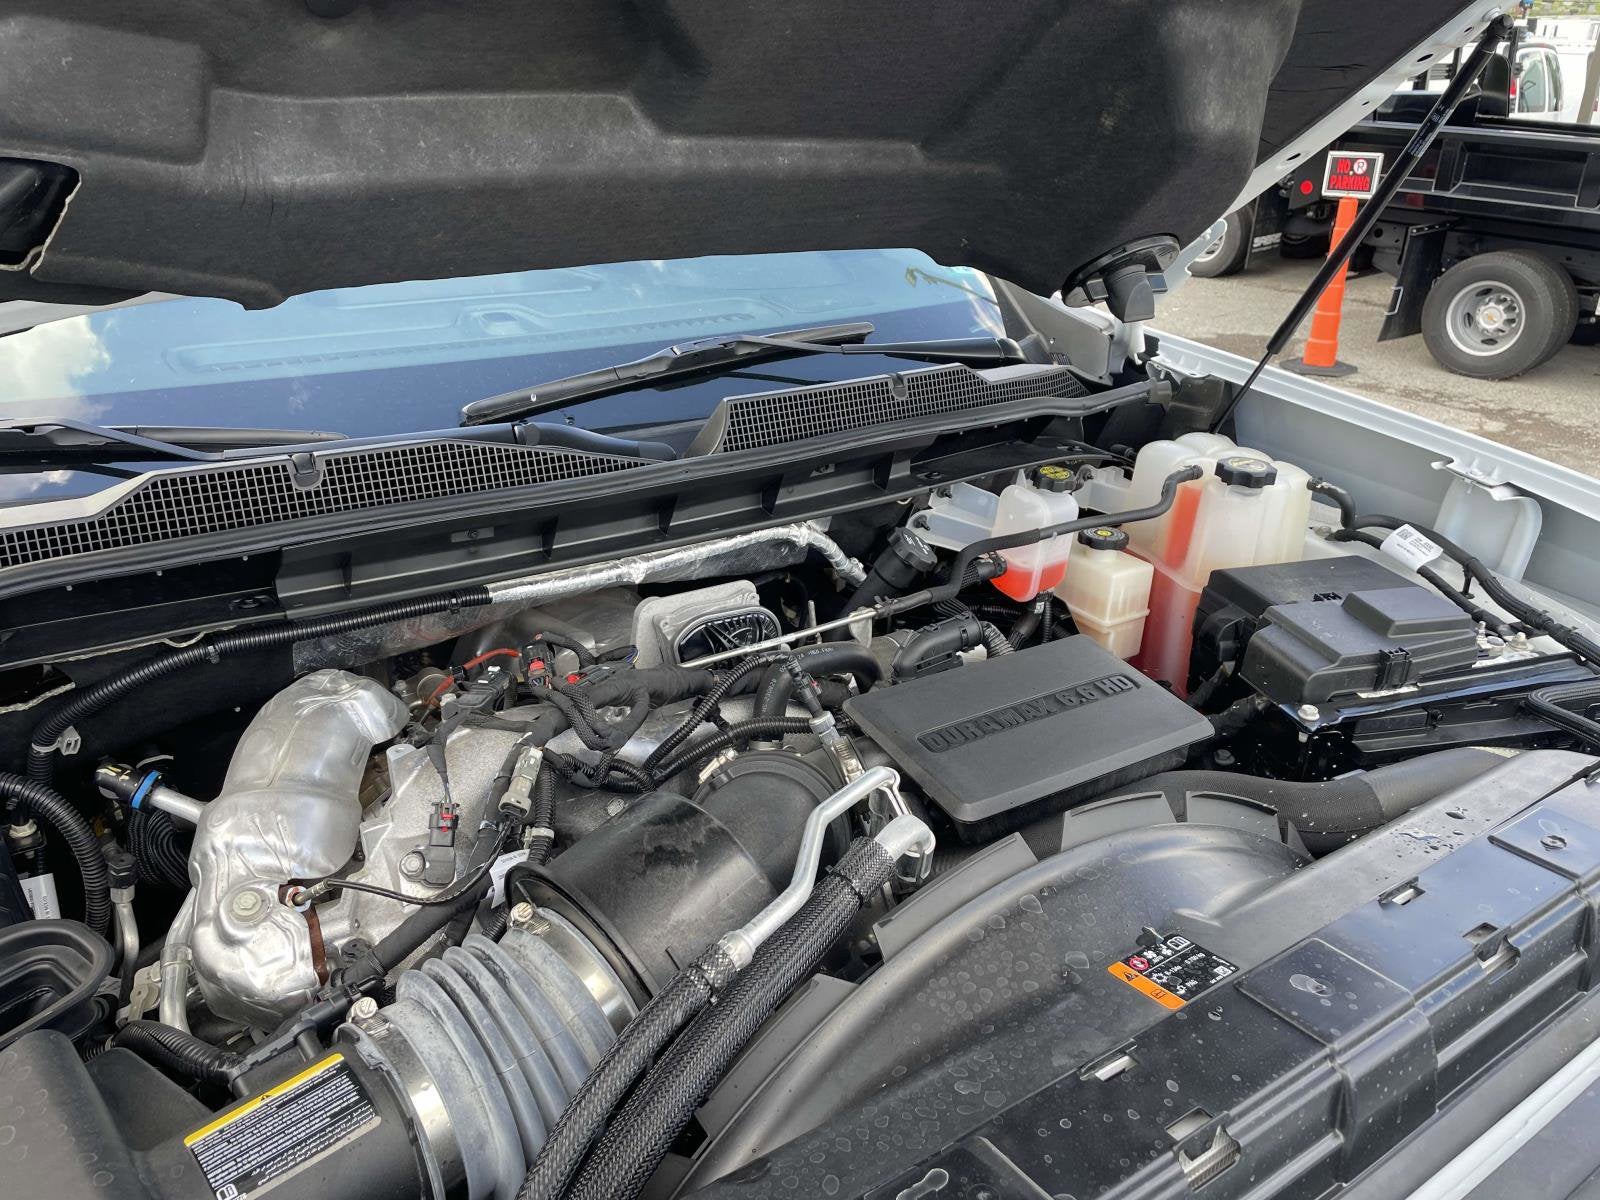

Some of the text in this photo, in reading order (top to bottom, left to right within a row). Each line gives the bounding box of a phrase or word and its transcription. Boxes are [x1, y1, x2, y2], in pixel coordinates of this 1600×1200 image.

[1337, 158, 1351, 174] NO
[1329, 175, 1370, 191] PARKING
[918, 675, 1134, 750] DURAMAX 6.6 HD
